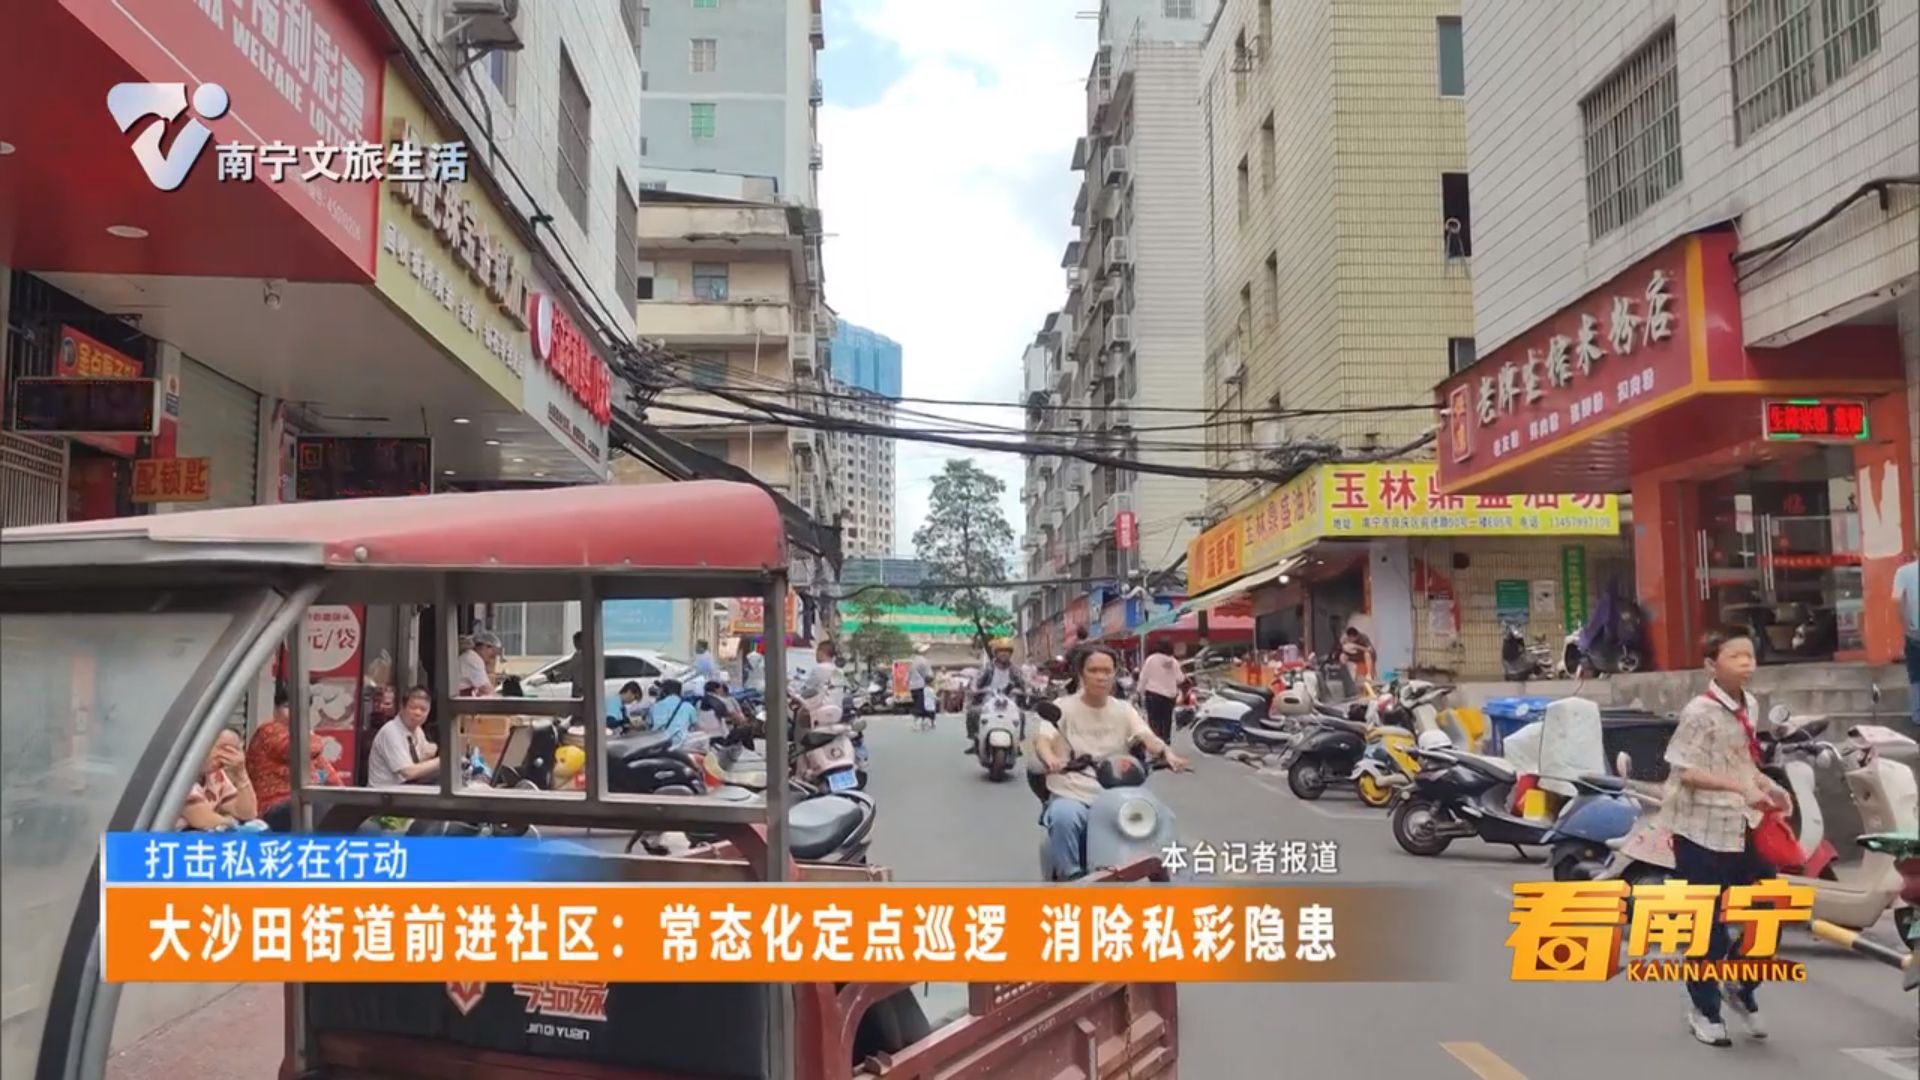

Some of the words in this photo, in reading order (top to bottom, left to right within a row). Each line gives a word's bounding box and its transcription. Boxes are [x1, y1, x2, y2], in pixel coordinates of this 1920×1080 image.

[232, 15, 303, 112] WELFARE
[232, 0, 365, 142] 福利彩票
[136, 460, 208, 495] 配锁匙
[1520, 516, 1539, 529] 电话
